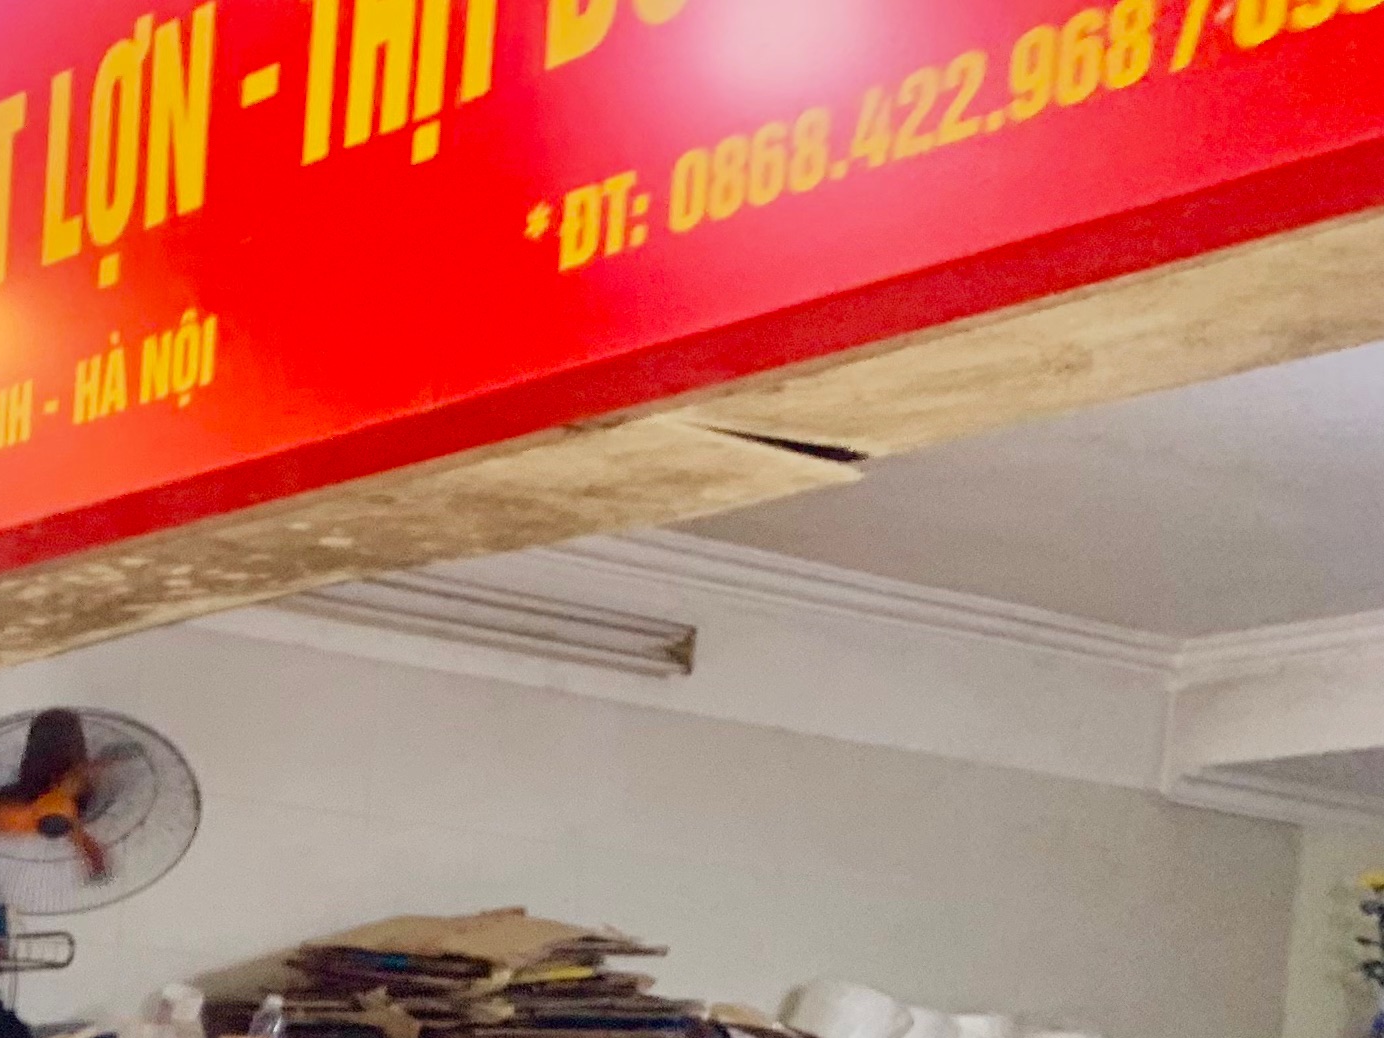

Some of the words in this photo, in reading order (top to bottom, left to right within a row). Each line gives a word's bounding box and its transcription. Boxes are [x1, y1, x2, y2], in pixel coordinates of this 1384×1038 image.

[41, 0, 217, 289] LỢN
[668, 0, 1155, 234] 0868.422.968
[72, 331, 128, 426] HÀ
[139, 308, 219, 408] NỘI
